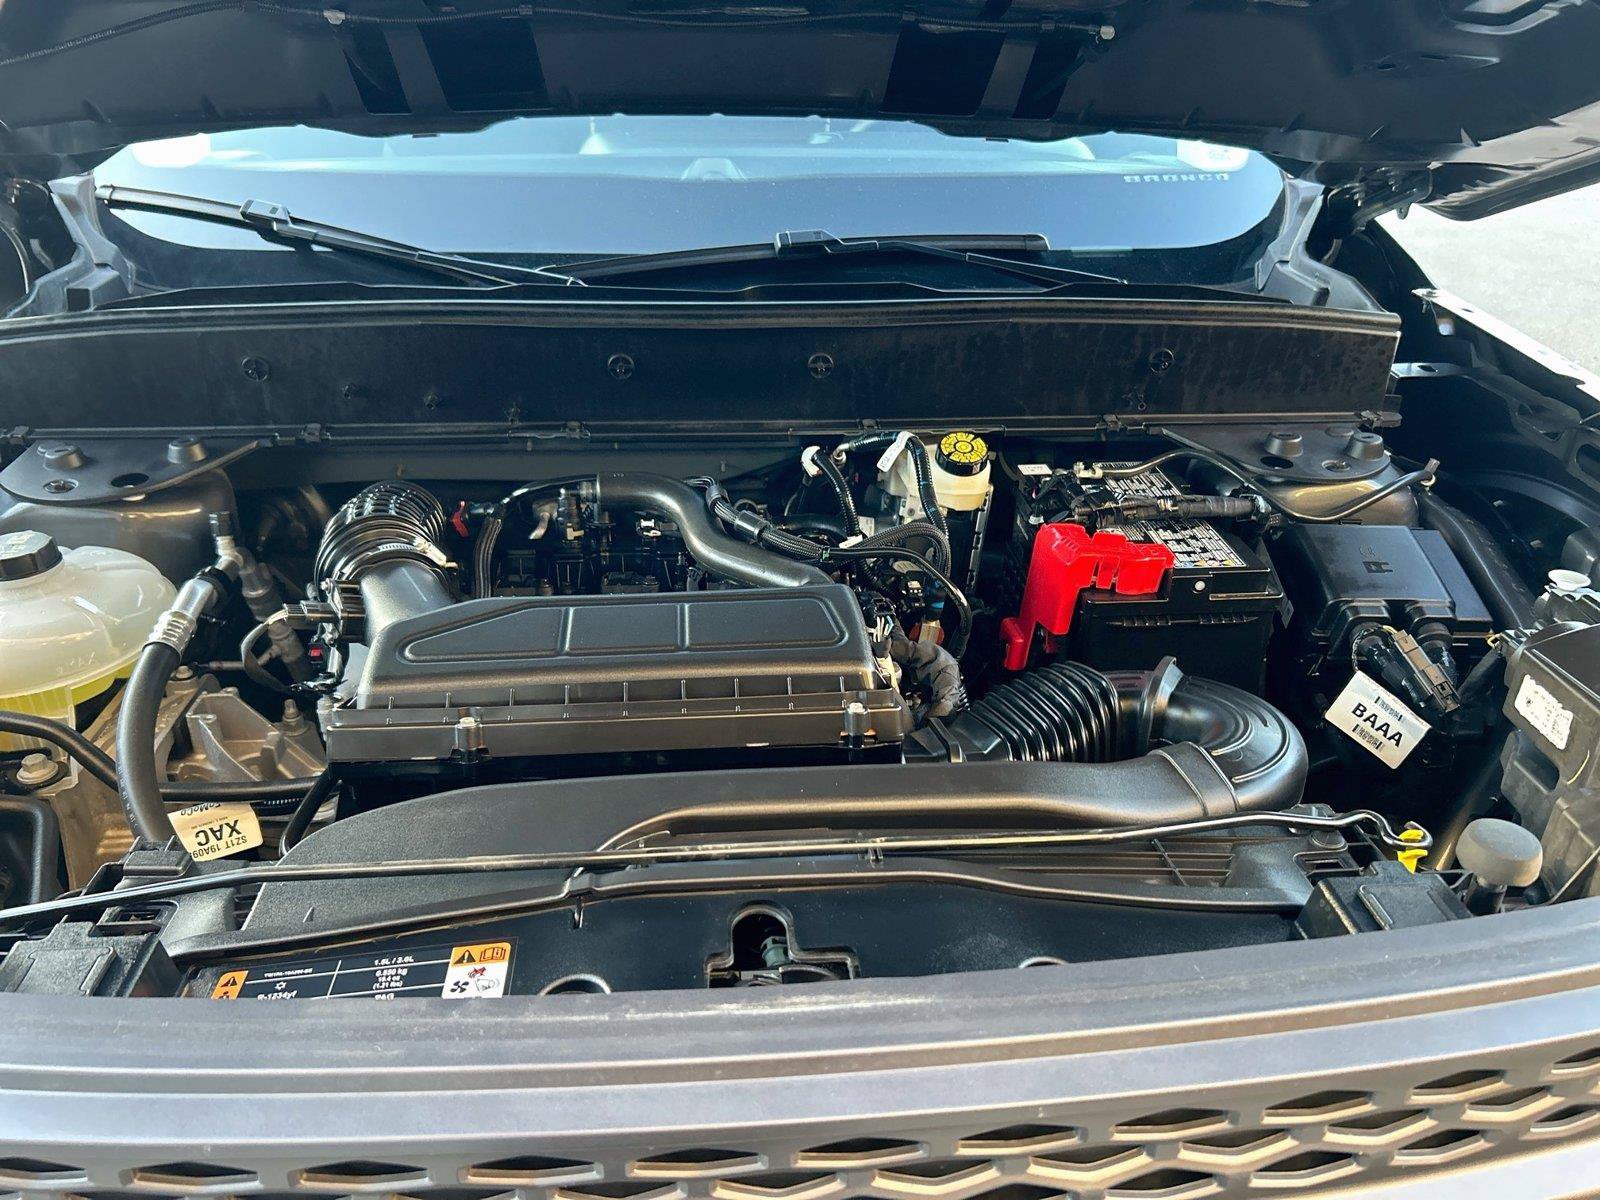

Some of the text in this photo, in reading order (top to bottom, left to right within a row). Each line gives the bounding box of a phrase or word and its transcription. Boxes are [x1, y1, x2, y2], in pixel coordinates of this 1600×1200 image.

[1123, 173, 1230, 183] BRONCO
[1351, 702, 1403, 748] BAAA
[195, 819, 242, 847] XAC
[225, 835, 248, 848] SZ1T
